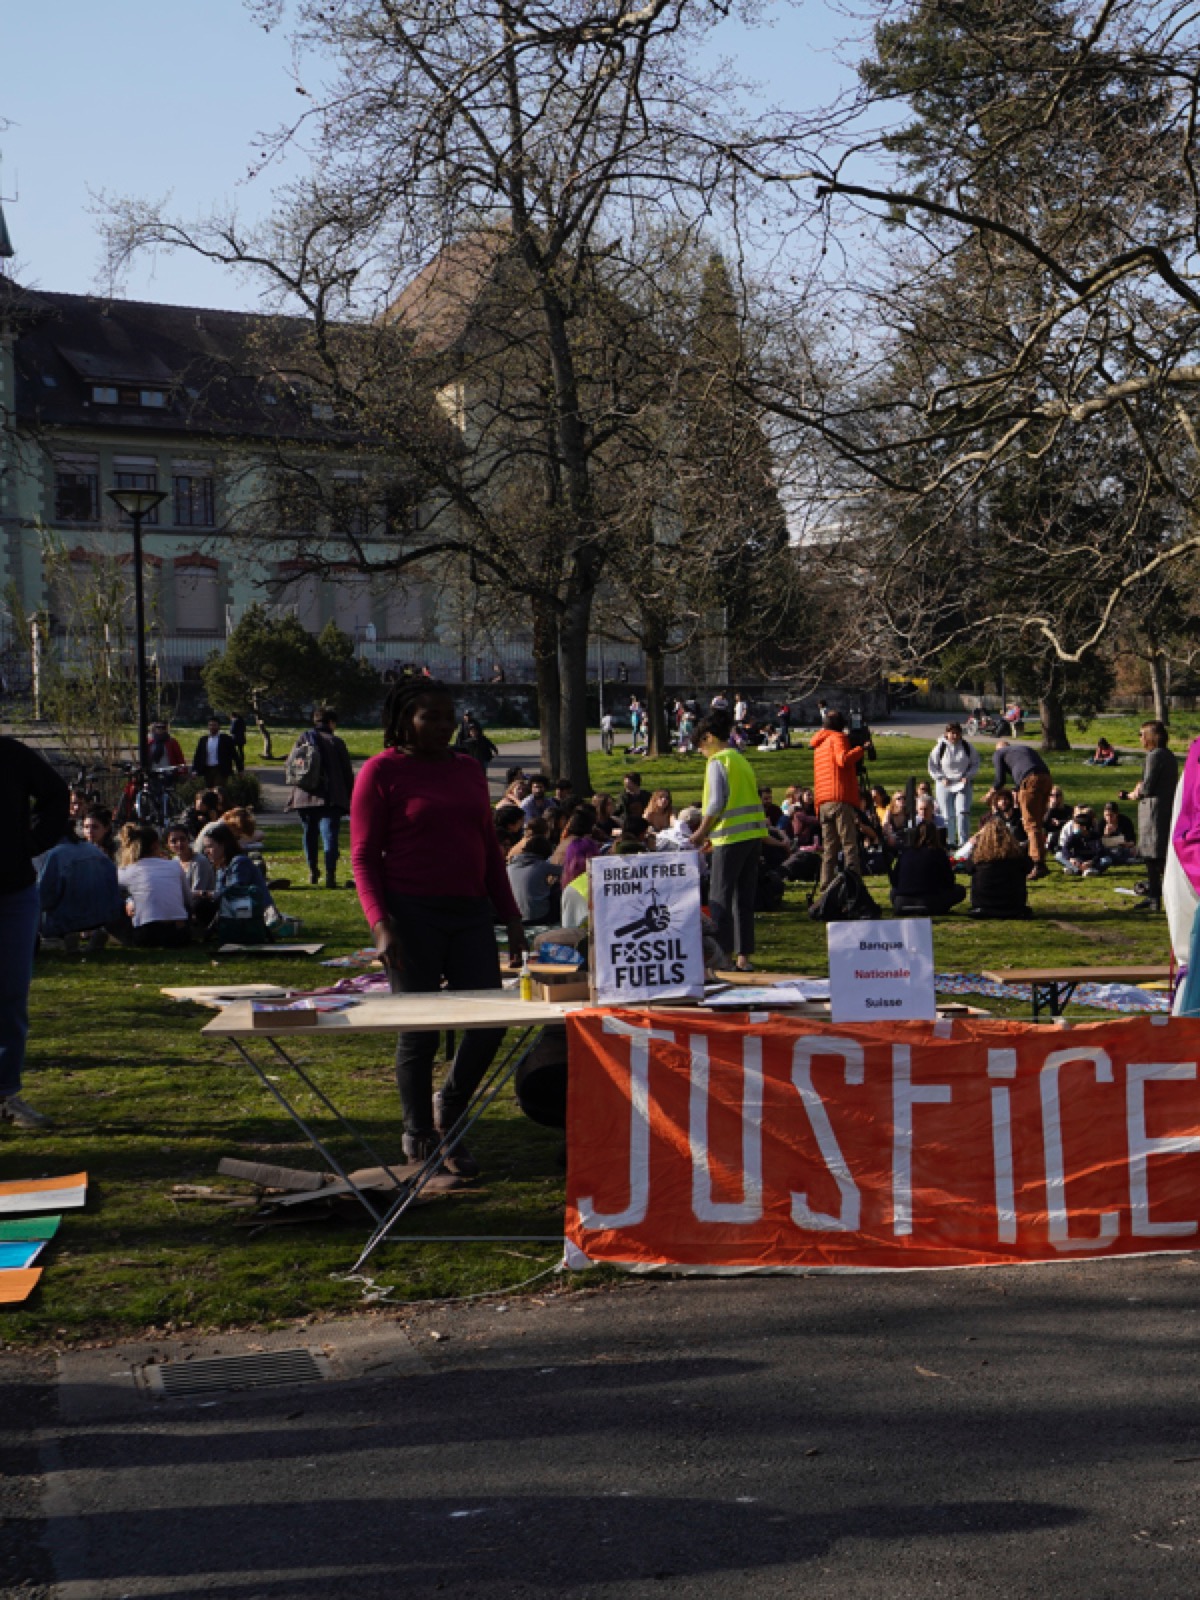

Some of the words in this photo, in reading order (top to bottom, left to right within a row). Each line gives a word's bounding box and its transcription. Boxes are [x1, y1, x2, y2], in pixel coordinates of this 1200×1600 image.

[604, 866, 648, 880] BREAK
[652, 864, 686, 878] FREE
[604, 882, 642, 896] FROM
[859, 941, 903, 951] Banque
[615, 962, 685, 988] FUELS
[854, 968, 910, 979] Nationale
[865, 998, 903, 1008] Suisse
